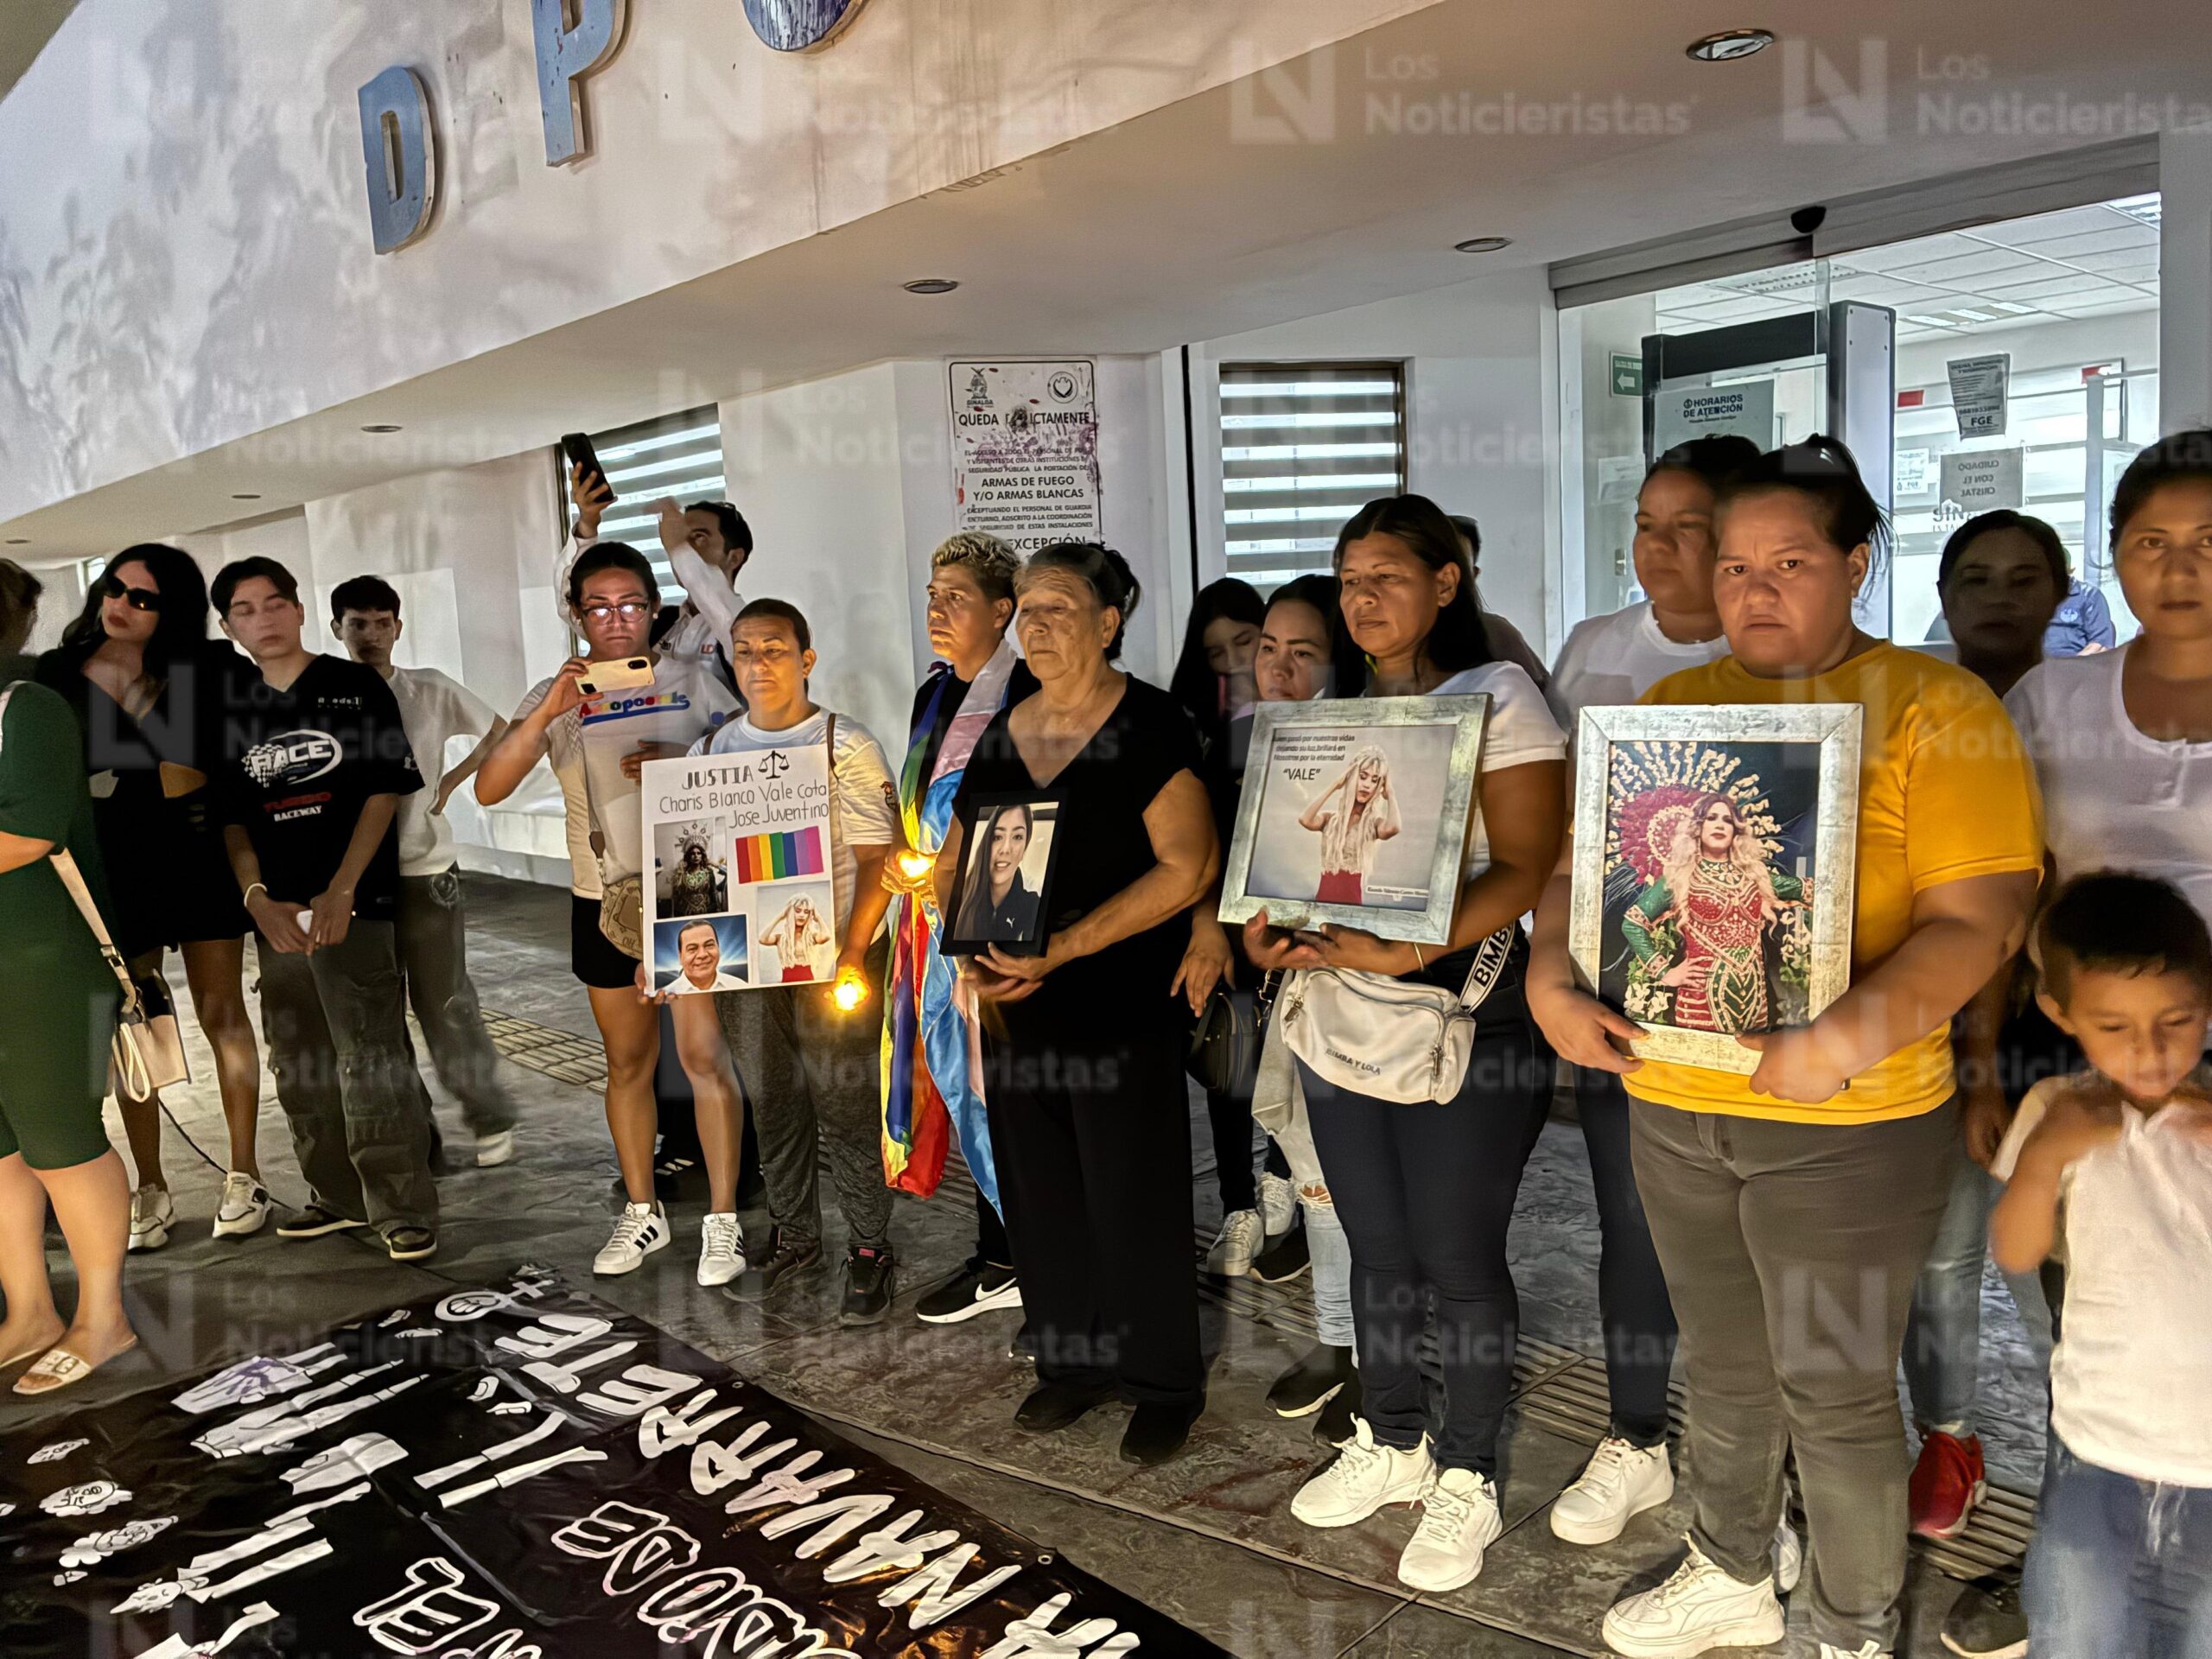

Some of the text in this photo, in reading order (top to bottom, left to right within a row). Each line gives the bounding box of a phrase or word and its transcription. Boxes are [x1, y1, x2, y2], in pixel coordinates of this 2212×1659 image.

[1694, 394, 1743, 407] HORARIOS
[959, 413, 999, 426] QUEDA
[1683, 410, 1695, 418] DE
[1971, 416, 1993, 426] FGE
[982, 476, 1074, 487] ARMAS DE FUEGO
[974, 488, 1084, 501] Y/O ARMAS BLANCAS
[251, 739, 333, 774] RACE
[682, 766, 753, 790] JUSTIA
[709, 789, 755, 809] Blanco
[758, 781, 793, 803] Vale
[274, 805, 322, 822] RACEWAY
[728, 801, 830, 830] Jose Juventino
[1325, 1047, 1381, 1075] BIMBA Y LOLA
[495, 1313, 1022, 1630] NAVARRETE
[551, 1501, 701, 1597] DE
